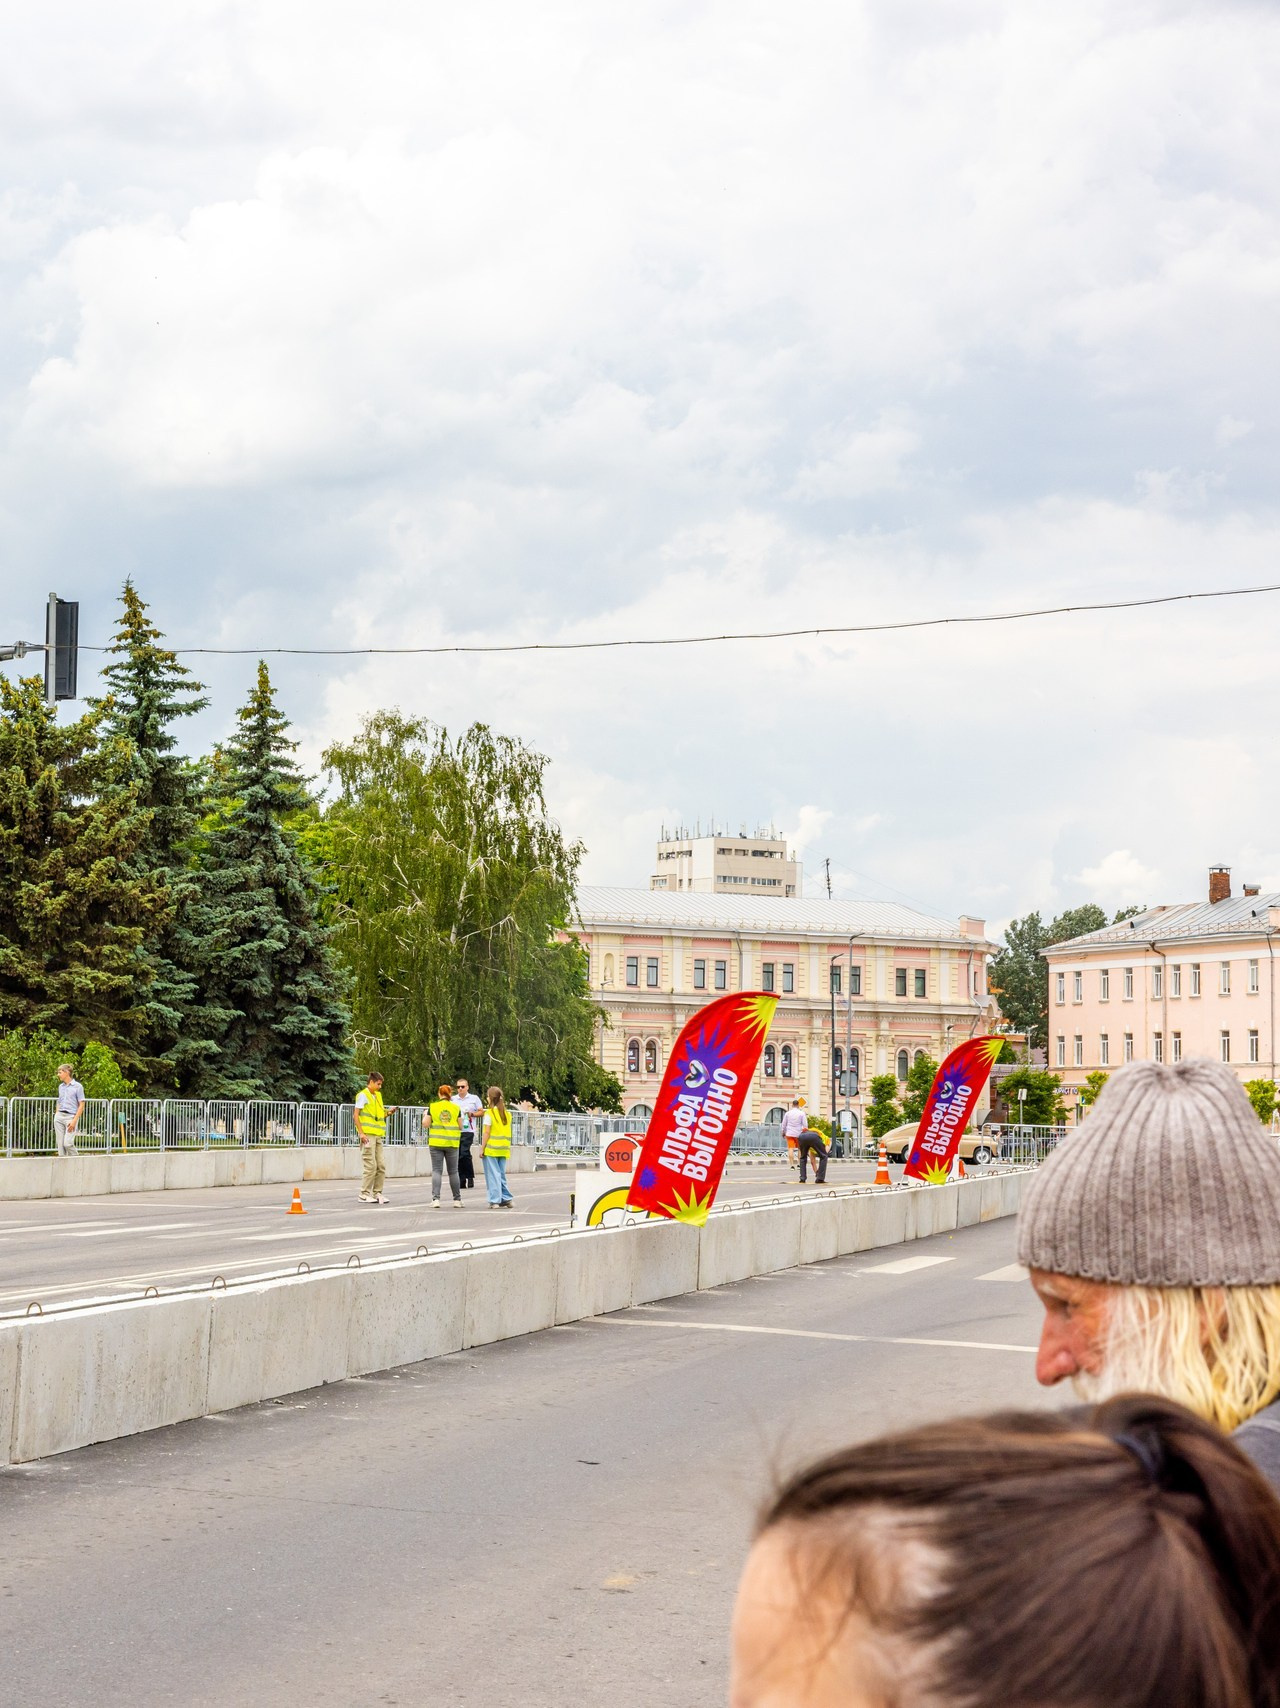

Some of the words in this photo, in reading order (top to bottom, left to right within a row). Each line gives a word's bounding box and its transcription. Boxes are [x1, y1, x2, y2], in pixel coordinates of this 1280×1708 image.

[658, 1094, 704, 1174] АЛЬФА
[681, 1067, 738, 1182] ВЫГОДНО
[920, 1102, 950, 1152] АЛЬФА
[931, 1085, 972, 1156] ВЫГОДНО
[608, 1151, 633, 1162] STO
